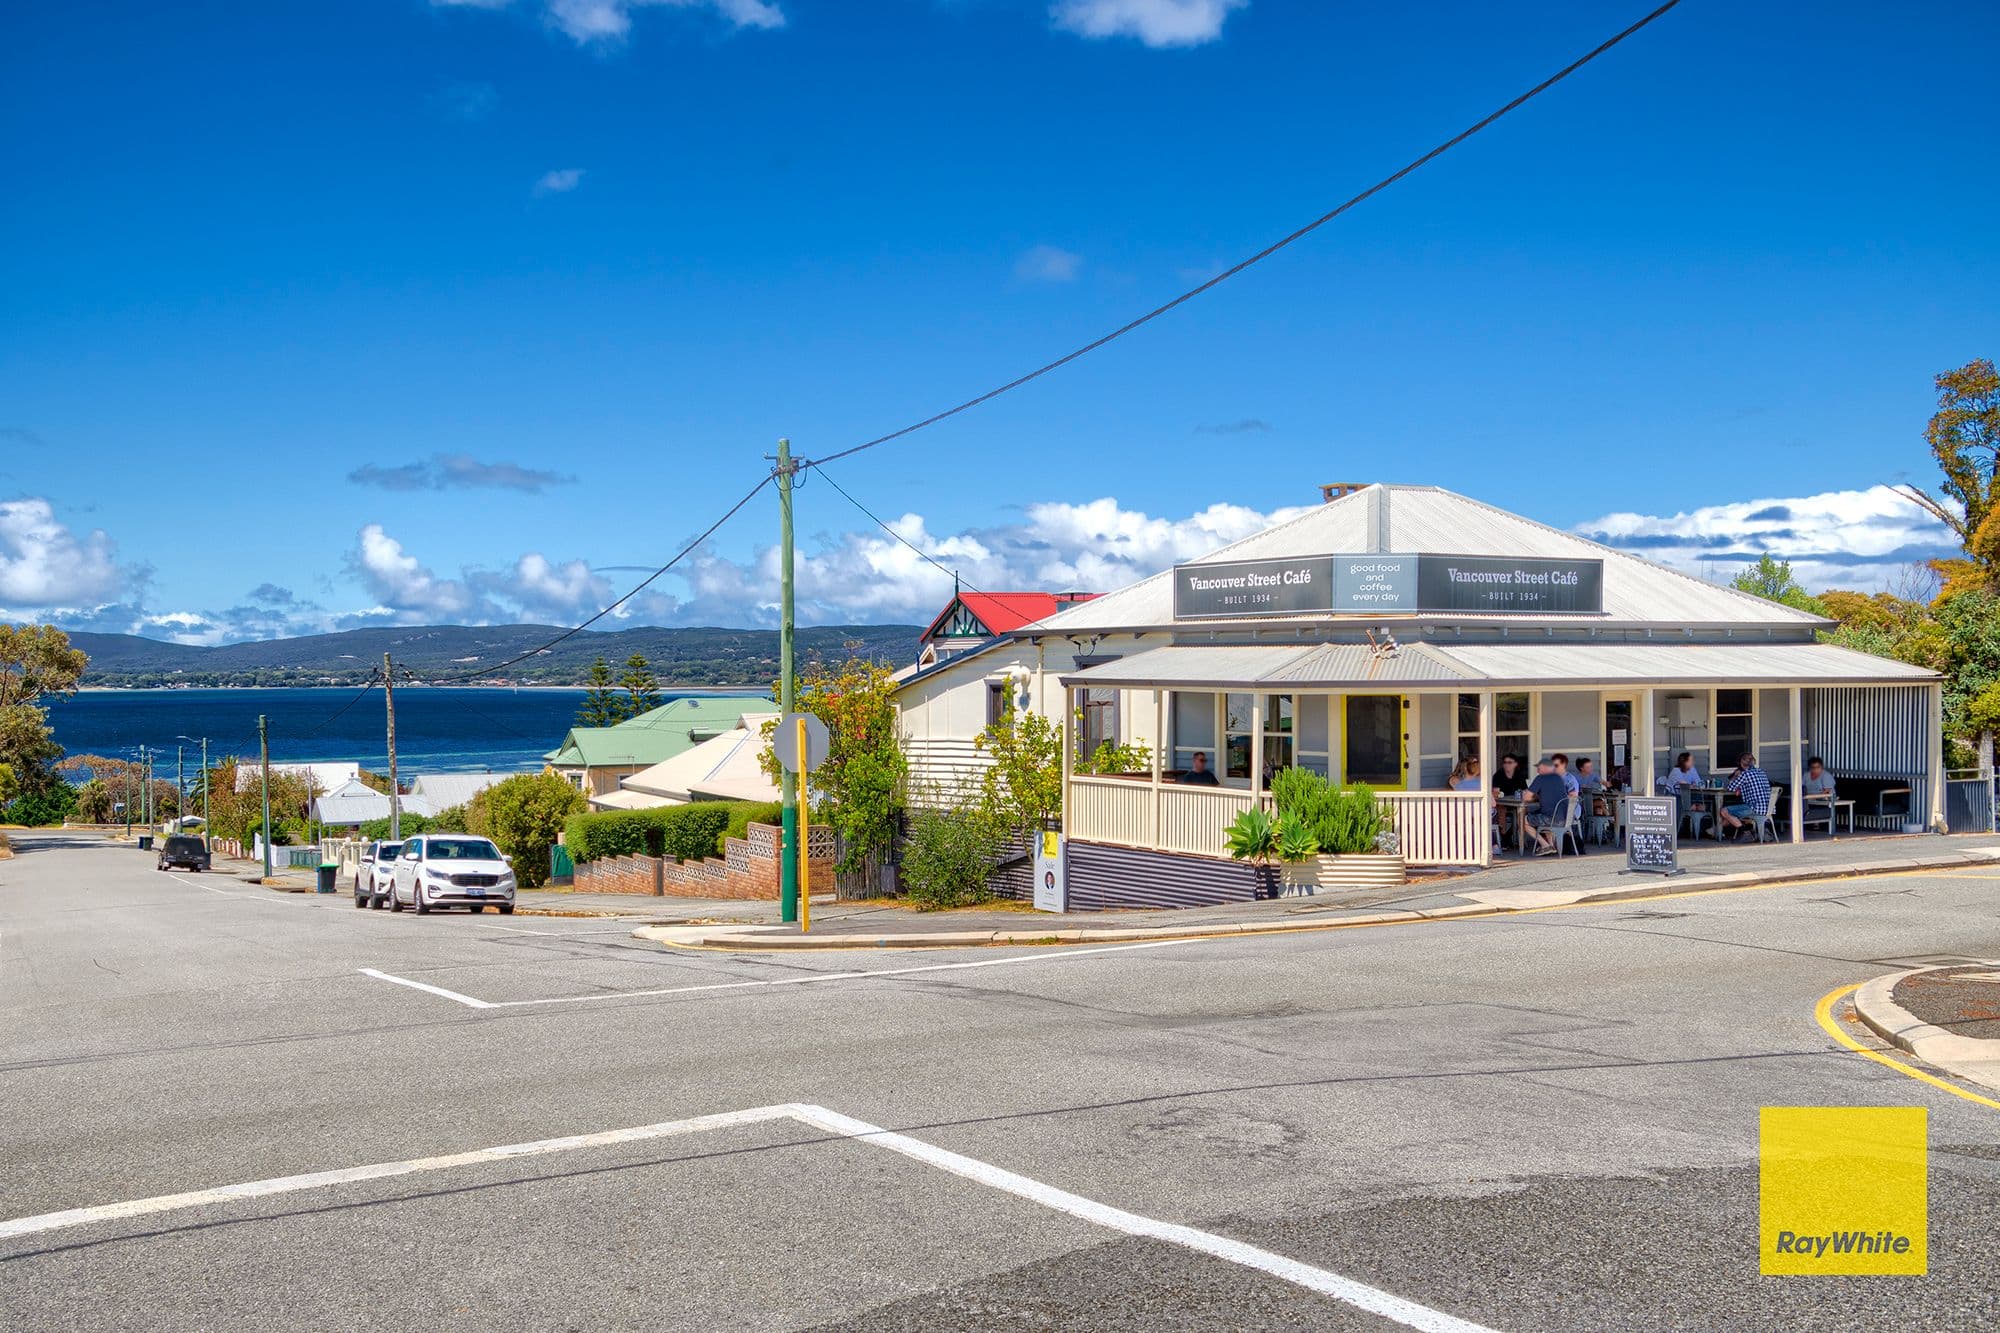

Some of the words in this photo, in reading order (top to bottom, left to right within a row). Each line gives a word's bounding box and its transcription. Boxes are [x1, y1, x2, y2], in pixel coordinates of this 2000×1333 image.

[1350, 563, 1375, 575] good
[1377, 563, 1401, 572] food
[1189, 576, 1246, 591] Vancouver
[1247, 572, 1282, 588] Street
[1283, 568, 1312, 585] Café
[1365, 573, 1384, 582] and
[1447, 567, 1513, 584] Vancouver
[1514, 570, 1549, 585] Street
[1551, 571, 1579, 586] Café
[1359, 582, 1393, 591] coffee
[1224, 595, 1247, 605] BUILT
[1252, 594, 1270, 604] 1934
[1352, 594, 1380, 603] every
[1381, 592, 1400, 603] day
[1489, 592, 1514, 601] BUILT
[1519, 592, 1539, 601] 1934
